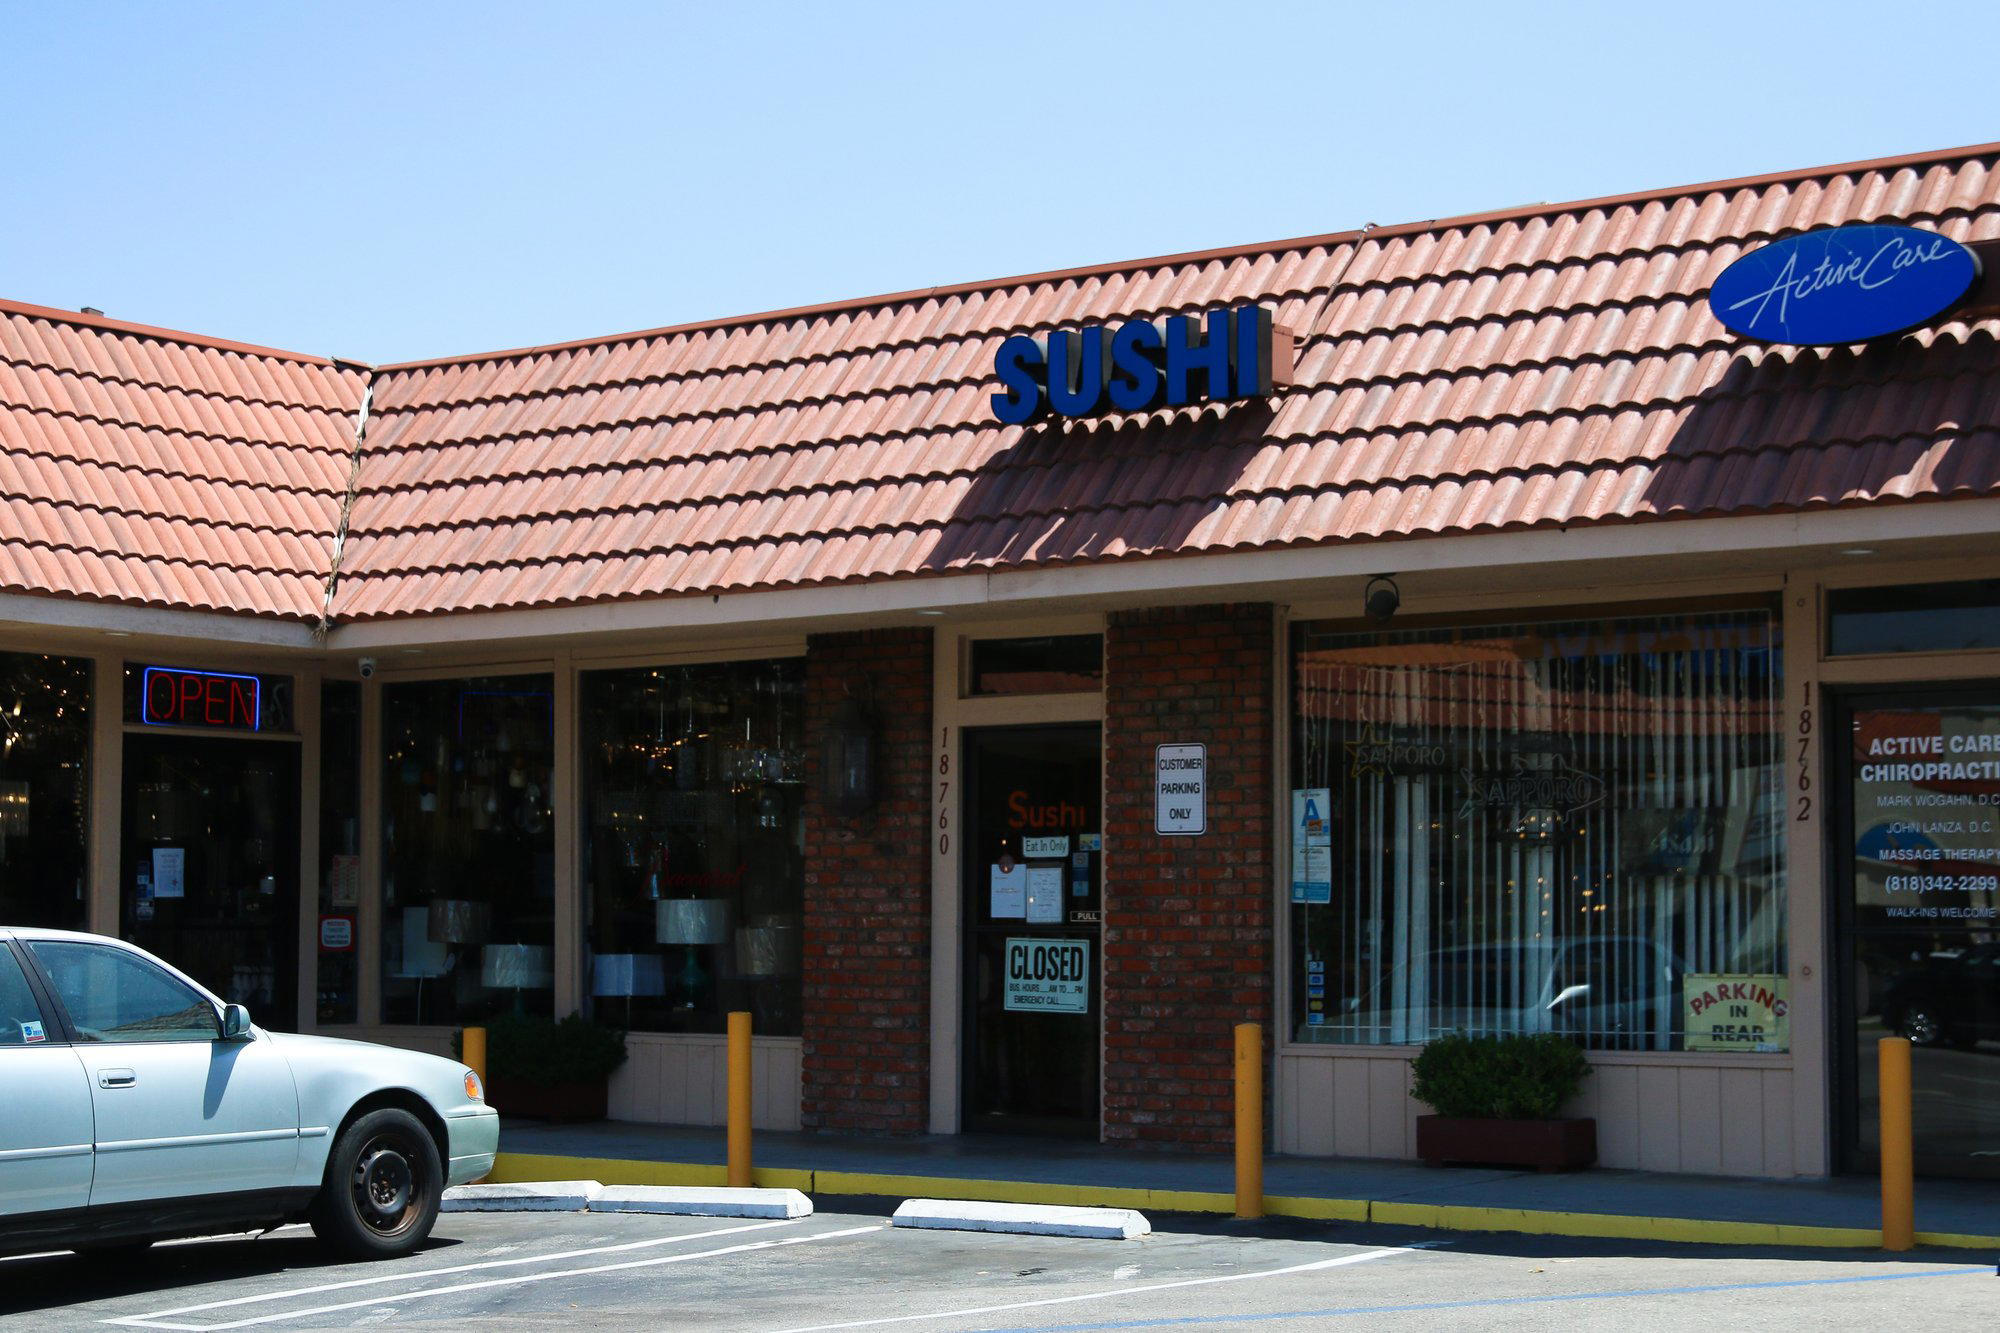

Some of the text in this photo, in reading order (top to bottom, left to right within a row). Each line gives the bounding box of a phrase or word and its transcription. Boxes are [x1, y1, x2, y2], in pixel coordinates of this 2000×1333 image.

[991, 304, 1261, 425] SUSHI
[148, 671, 257, 728] OPEN
[1796, 681, 1811, 821] 18762
[1869, 736, 1944, 755] ACTIVE
[1159, 758, 1202, 771] CUSTOMER
[1358, 745, 1446, 766] SAPPORO
[938, 726, 949, 855] 18760
[1161, 782, 1200, 795] PARKING
[1473, 775, 1592, 807] SAPPORO
[1008, 790, 1087, 830] Sushi
[1876, 795, 1912, 807] MARK
[1168, 808, 1191, 820] ONLY
[1301, 798, 1319, 827] A
[1886, 822, 1921, 834] JOHN
[1026, 840, 1039, 852] Eat
[1040, 840, 1048, 852] In
[1050, 839, 1067, 853] Only
[1878, 848, 1940, 861] MASSAGE
[1885, 876, 1998, 894] (818)342-2299
[1077, 912, 1097, 920] PULL
[1886, 907, 1997, 918] WALK-INS WELCOME
[1010, 945, 1084, 982] CLOSED
[1014, 995, 1060, 1006] EMERGENCY CALL
[1690, 982, 1788, 1017] PARKING
[1730, 1005, 1748, 1018] IN
[1712, 1024, 1765, 1042] REAR
